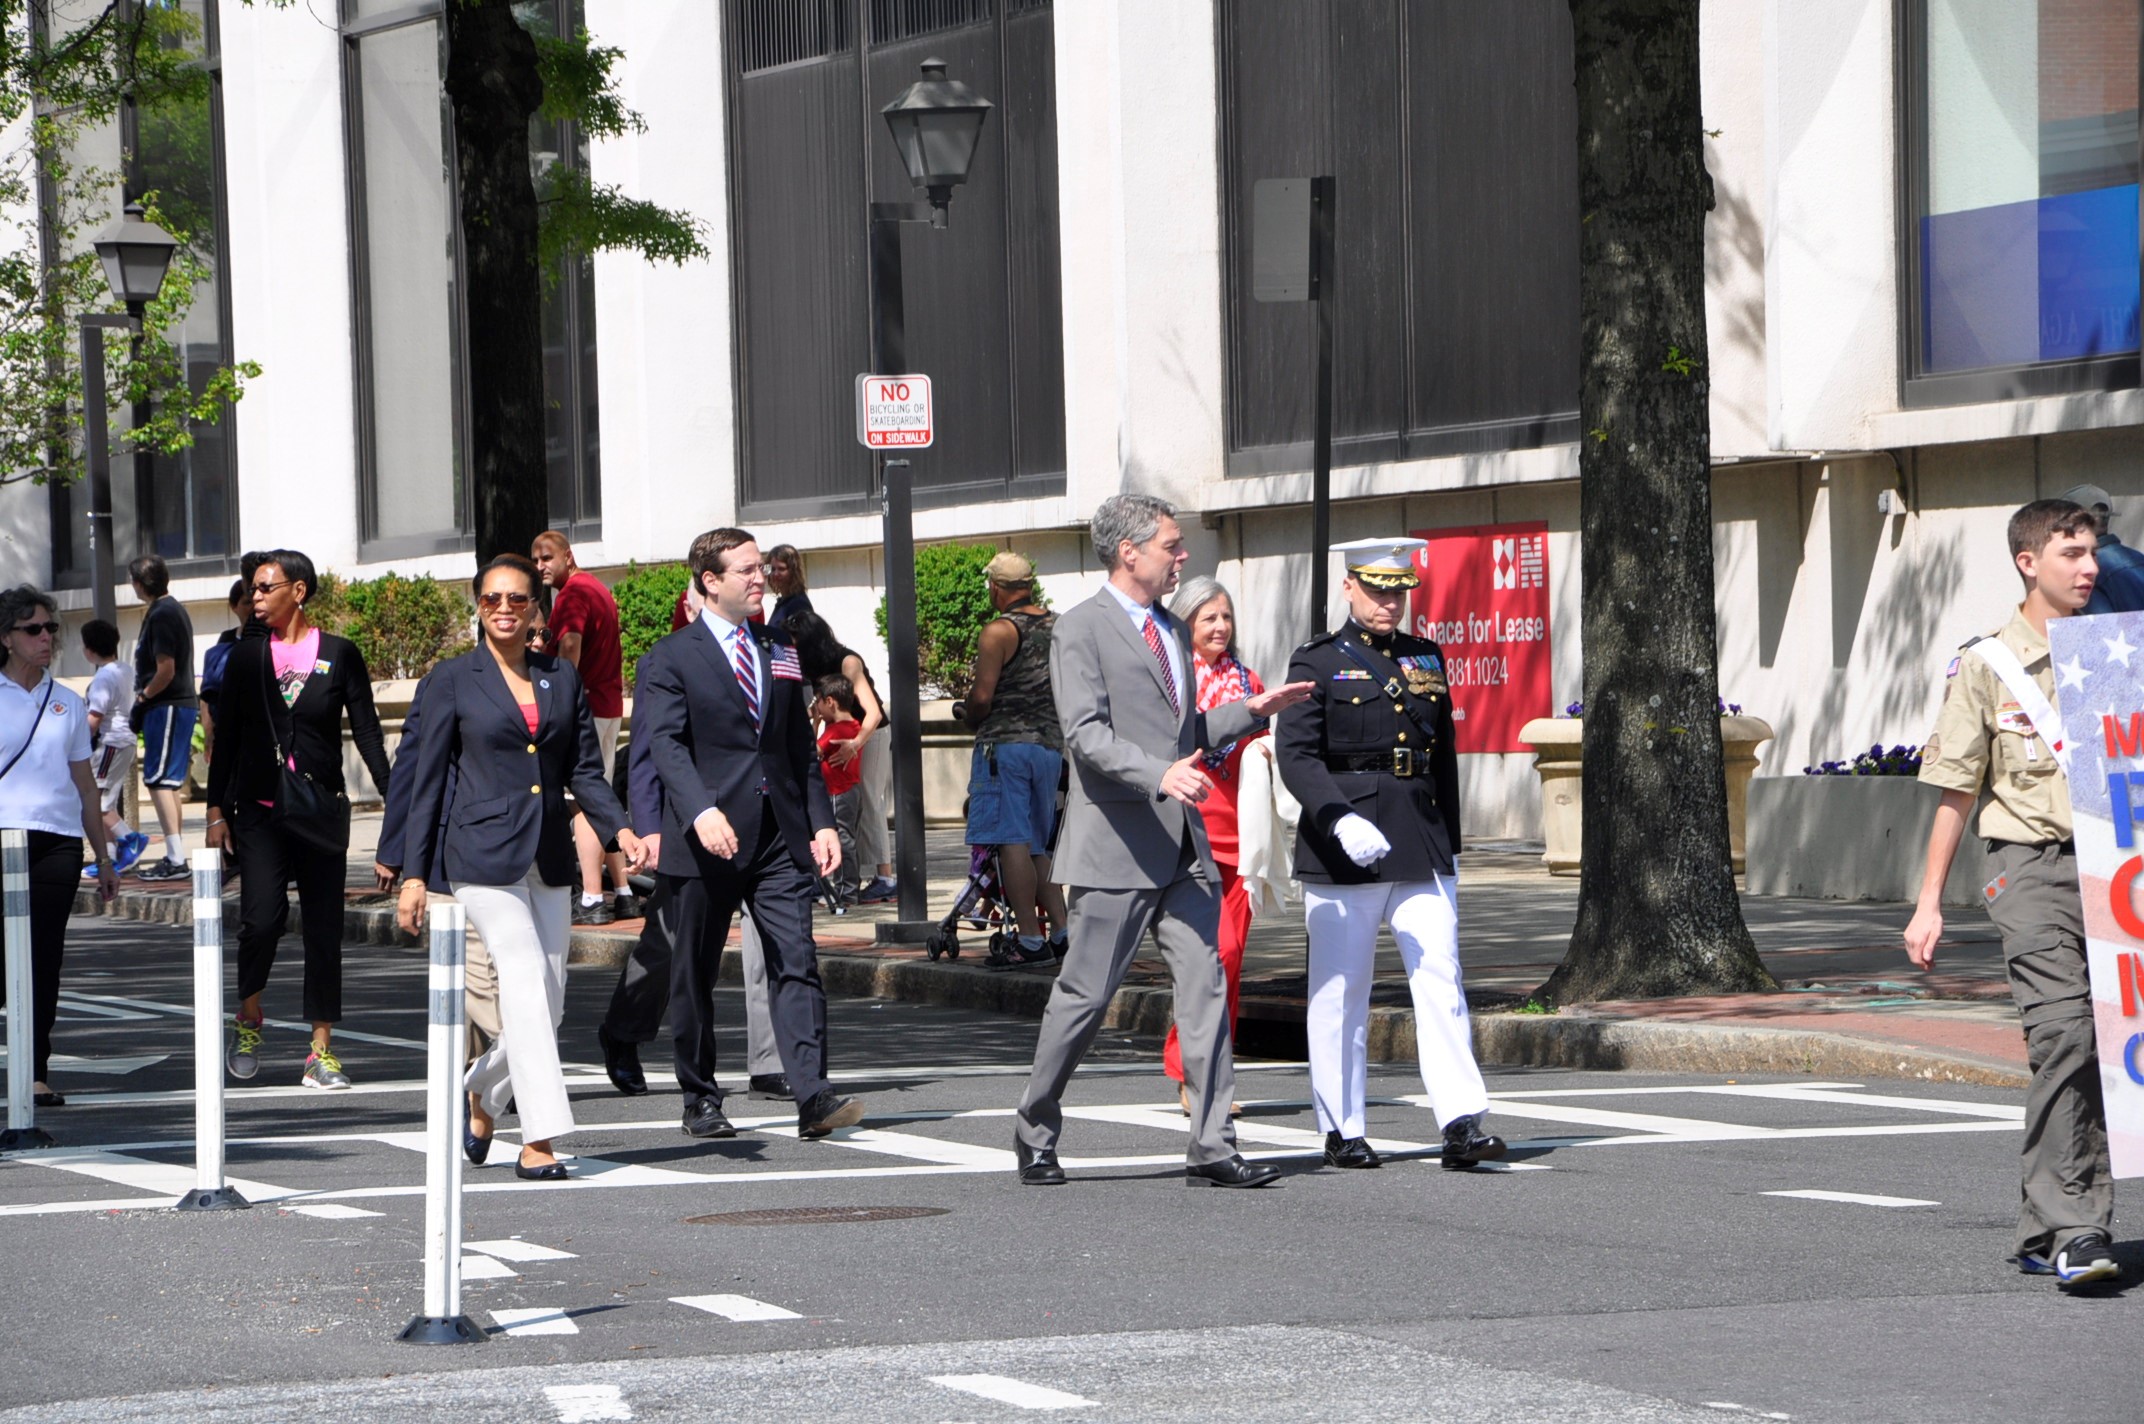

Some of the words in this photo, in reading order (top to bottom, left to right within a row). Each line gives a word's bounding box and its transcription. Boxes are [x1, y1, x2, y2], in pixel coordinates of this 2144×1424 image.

[881, 383, 910, 401] NO
[870, 404, 911, 414] BICYCLING
[913, 403, 925, 413] OR
[870, 415, 926, 426] SKATEBOARDING
[870, 432, 883, 444] ON
[885, 431, 927, 443] SIDEWALK
[1416, 614, 1464, 645] Space
[1467, 611, 1492, 644] for
[1495, 610, 1544, 643] Lease
